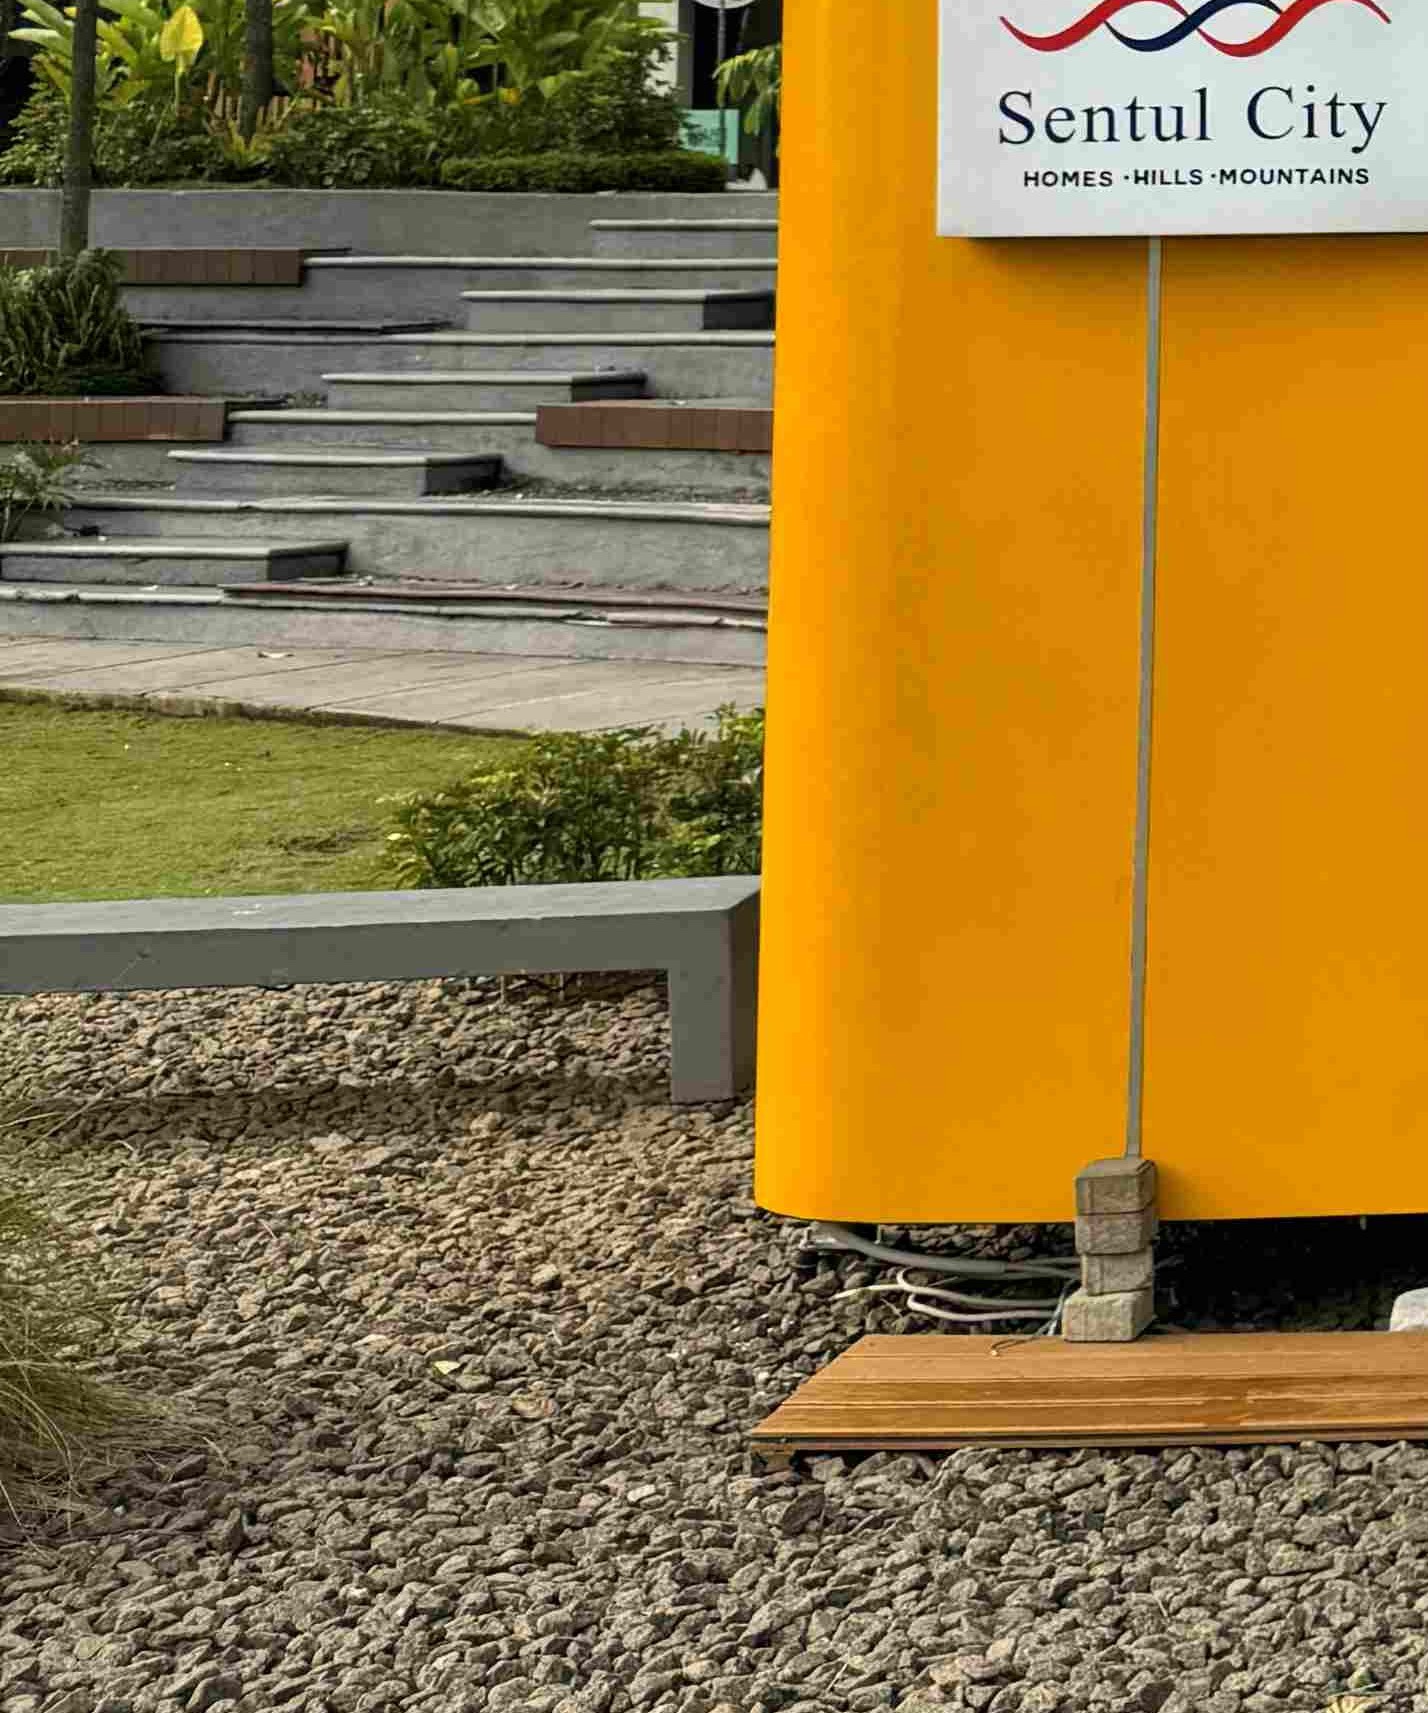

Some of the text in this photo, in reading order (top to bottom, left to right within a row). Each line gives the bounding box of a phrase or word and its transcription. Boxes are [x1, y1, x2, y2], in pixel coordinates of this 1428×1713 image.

[998, 84, 1388, 155] Sentul City
[1023, 170, 1113, 188] HOMES
